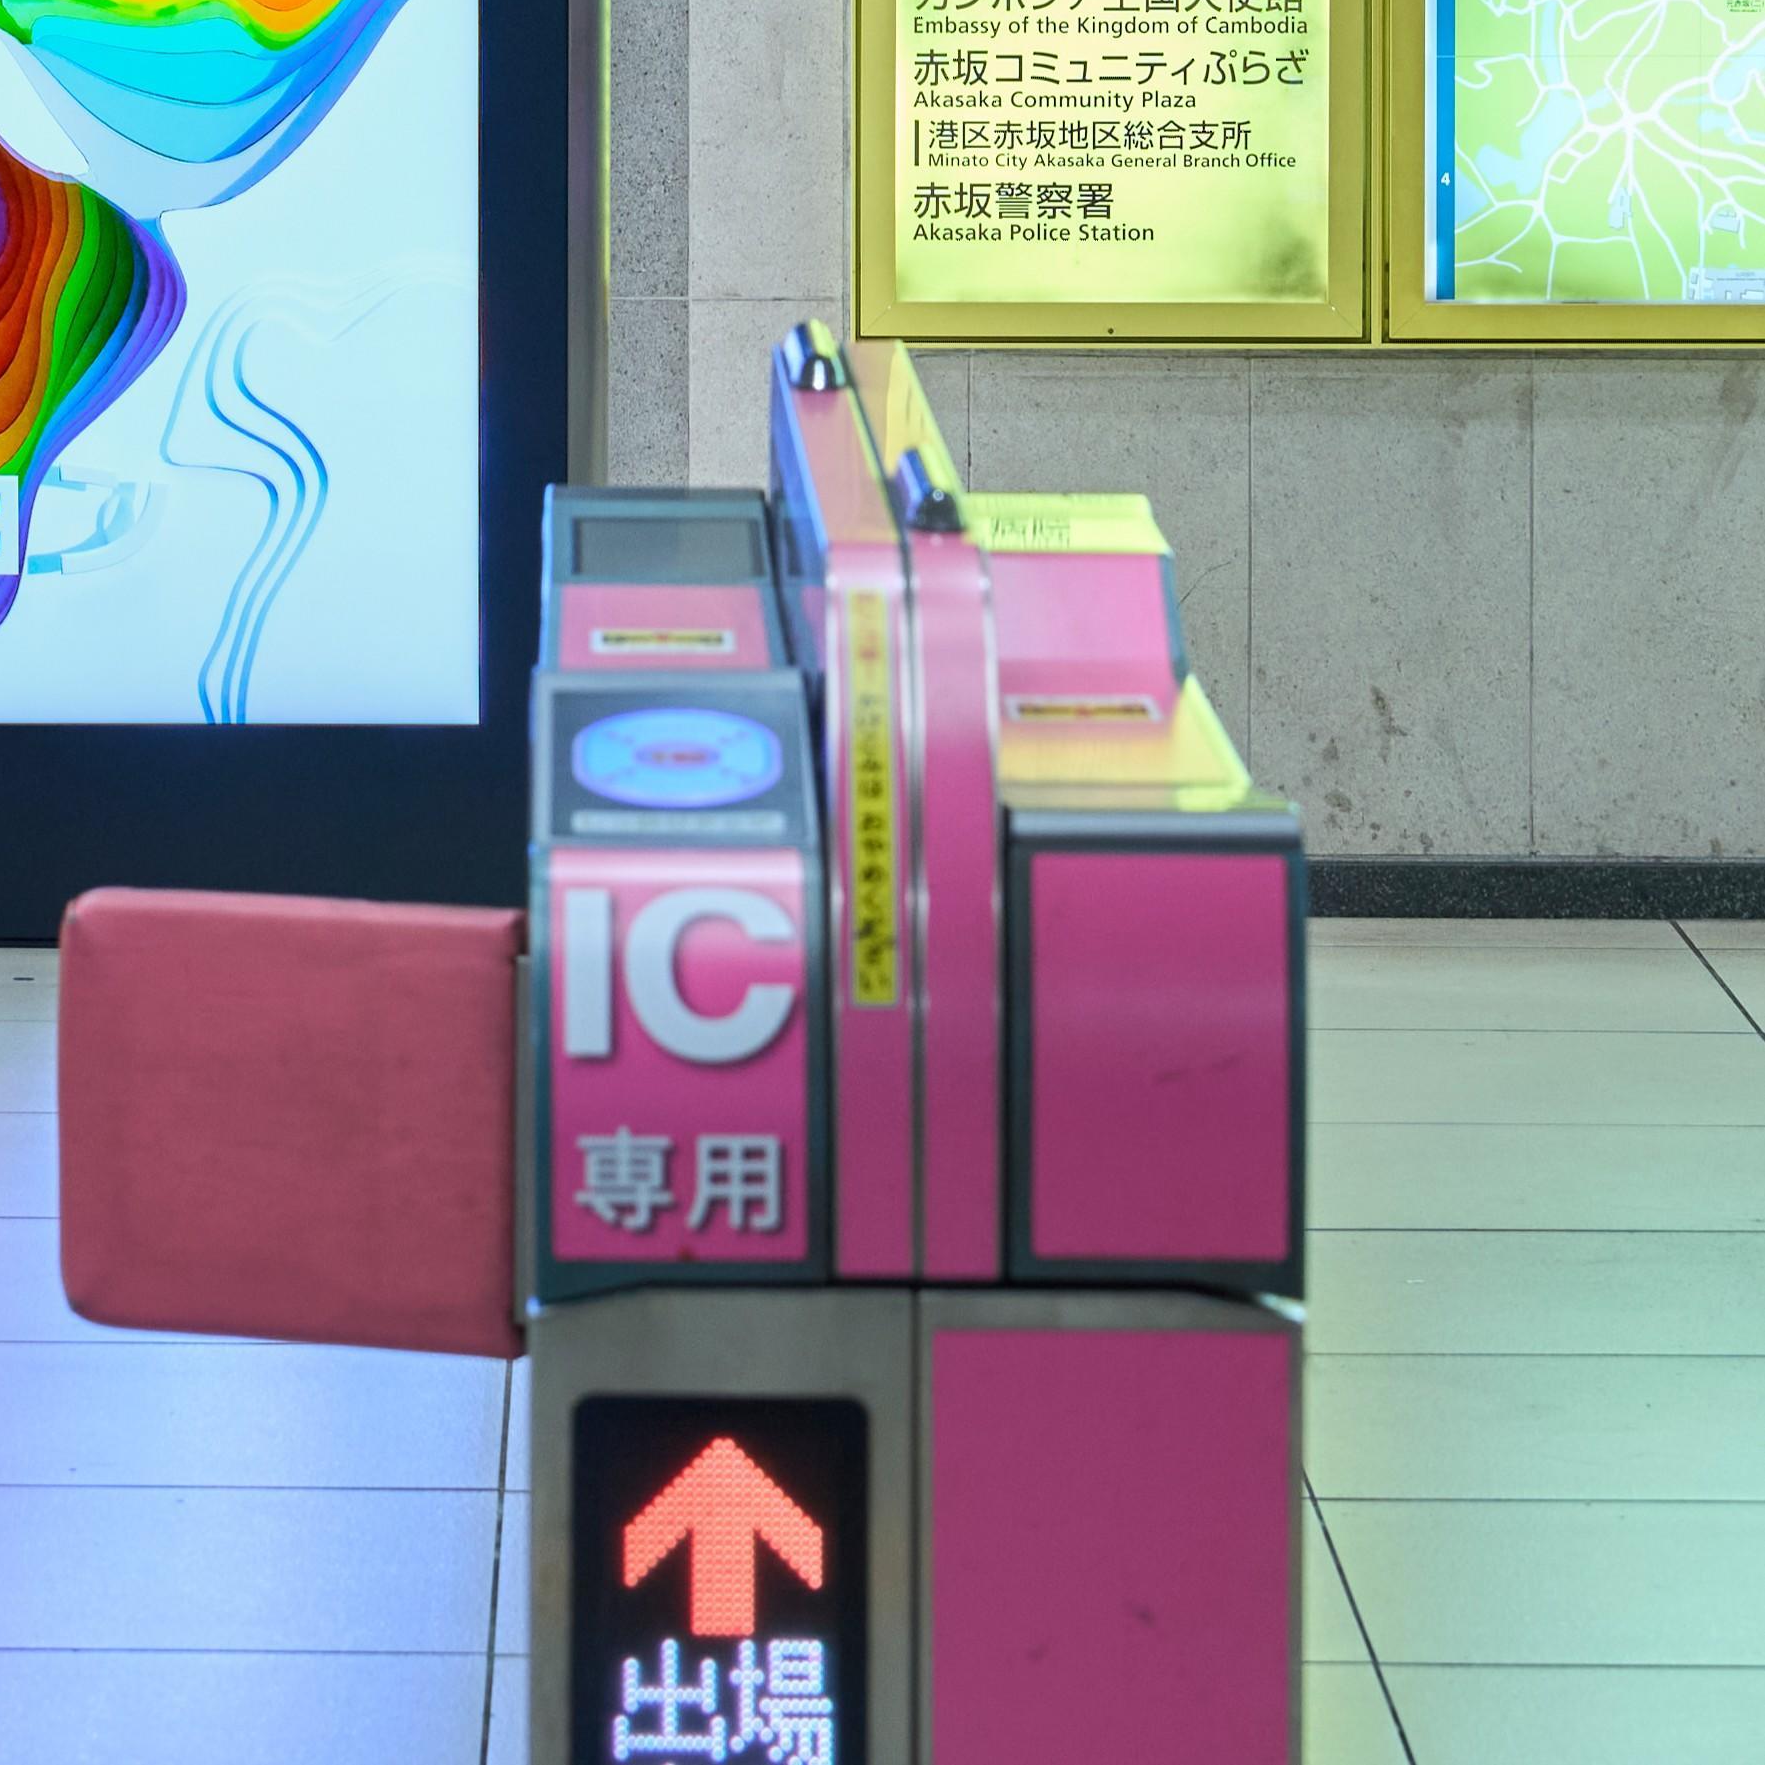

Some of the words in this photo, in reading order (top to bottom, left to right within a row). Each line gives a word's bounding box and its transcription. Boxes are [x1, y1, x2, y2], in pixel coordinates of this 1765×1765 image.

[914, 15, 1001, 39] Embassy
[1008, 15, 1029, 34] of
[1036, 15, 1070, 34] the
[1077, 15, 1169, 39] Kingdom
[1177, 15, 1198, 34] of
[1205, 15, 1308, 34] Cambodia
[913, 48, 1310, 87] 赤坂コミュニティぷらざ
[913, 90, 1002, 108] Akasaka
[1010, 90, 1134, 113] Community
[1142, 90, 1196, 108] Plaza
[928, 119, 1252, 151] 港区赤坂地区総合支所
[928, 153, 989, 167] Minato
[995, 153, 1028, 171] City
[1033, 152, 1105, 168] Akasaka
[1111, 153, 1177, 168] General
[1183, 153, 1240, 168] Branch
[1245, 152, 1296, 168] Office
[1441, 173, 1450, 185] 4
[913, 181, 1114, 220] 赤坂警察署
[913, 222, 1002, 242] Akasaka
[1010, 222, 1071, 242] Police
[1078, 223, 1154, 242] Station
[563, 888, 796, 1064] IC
[574, 1125, 784, 1231] 専用
[612, 1639, 832, 1765] 出場
